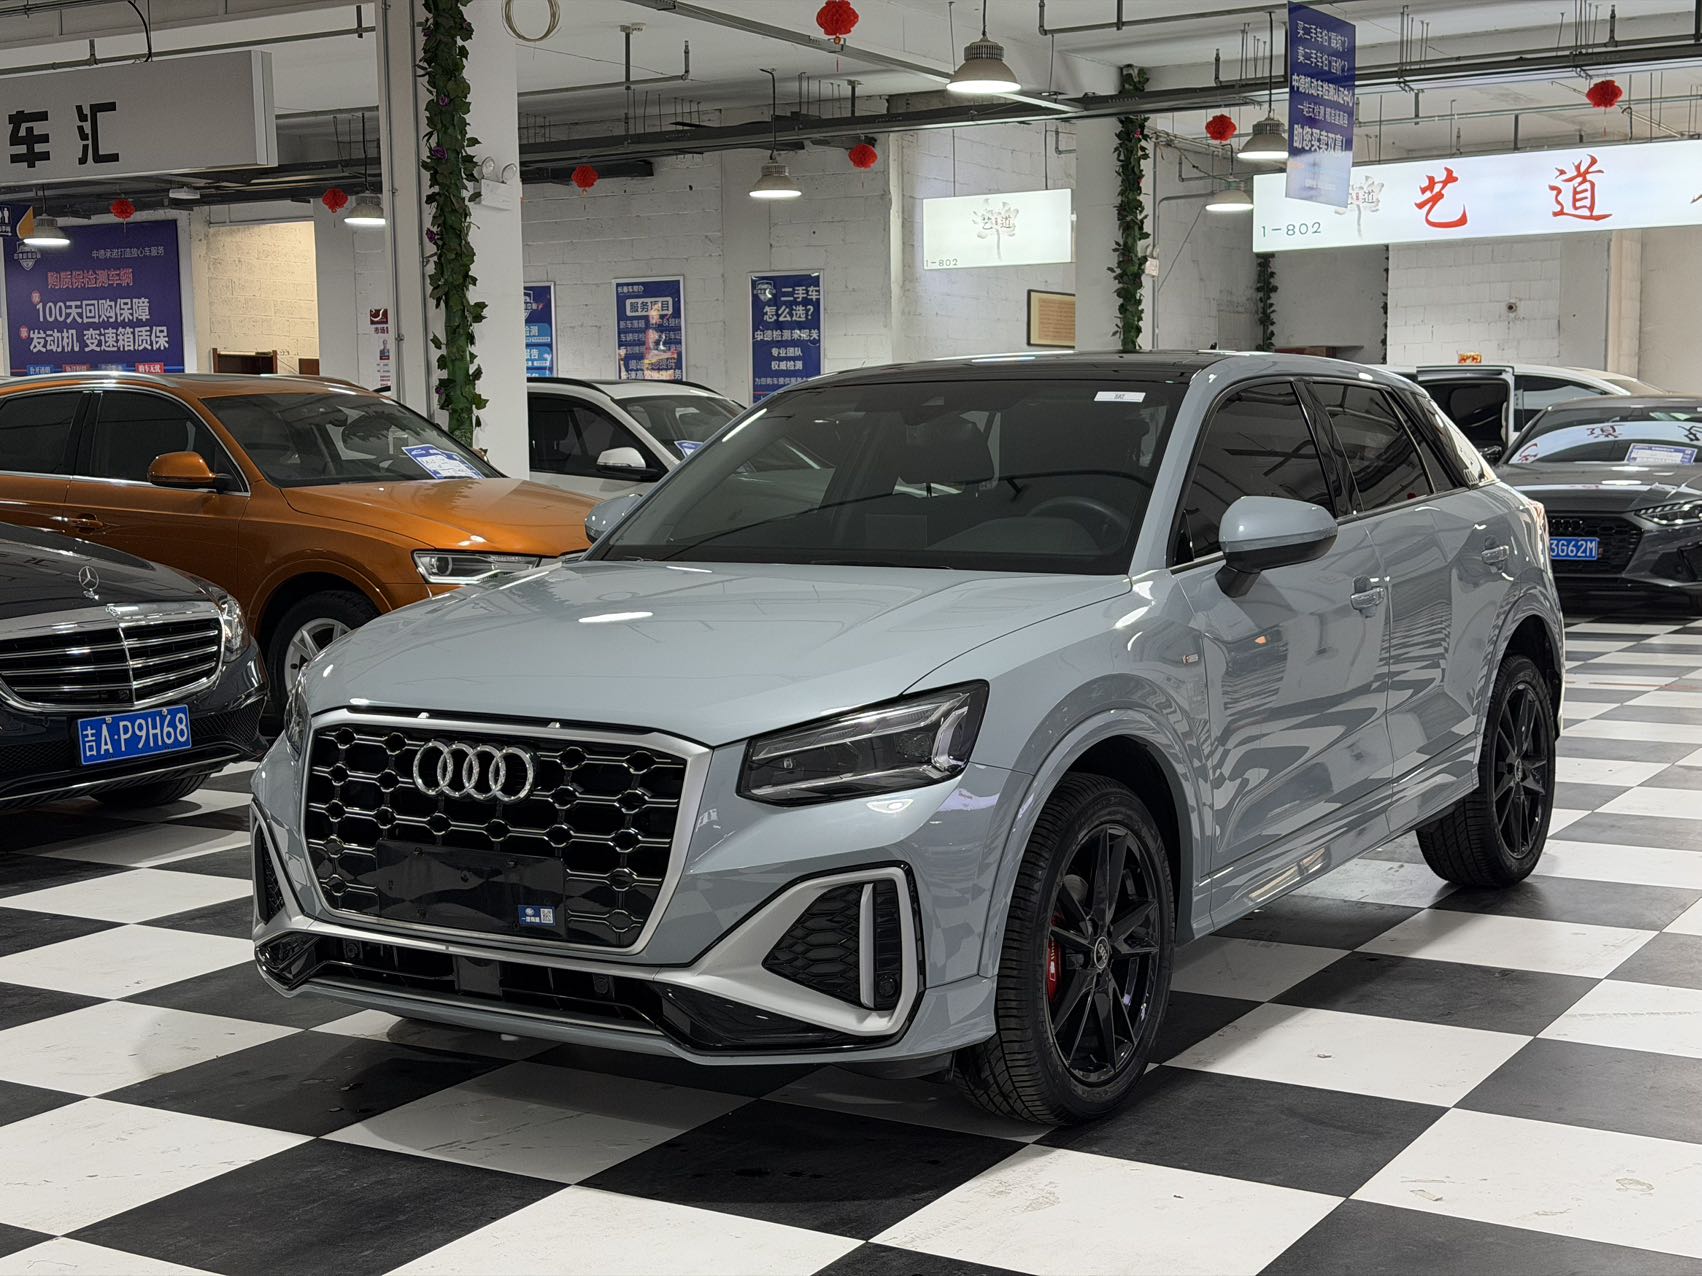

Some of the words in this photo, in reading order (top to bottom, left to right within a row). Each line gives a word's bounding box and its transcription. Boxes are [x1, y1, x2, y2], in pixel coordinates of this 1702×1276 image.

[8, 101, 120, 168] 车汇
[1260, 222, 1322, 239] 1-802
[925, 258, 959, 268] 1-802
[780, 286, 820, 302] 二手车
[36, 298, 150, 324] 100天回购保障
[630, 300, 670, 314] 服务项目
[29, 328, 79, 353] 发动机
[84, 326, 169, 352] 变速箱质保
[1550, 540, 1596, 557] 3G62M
